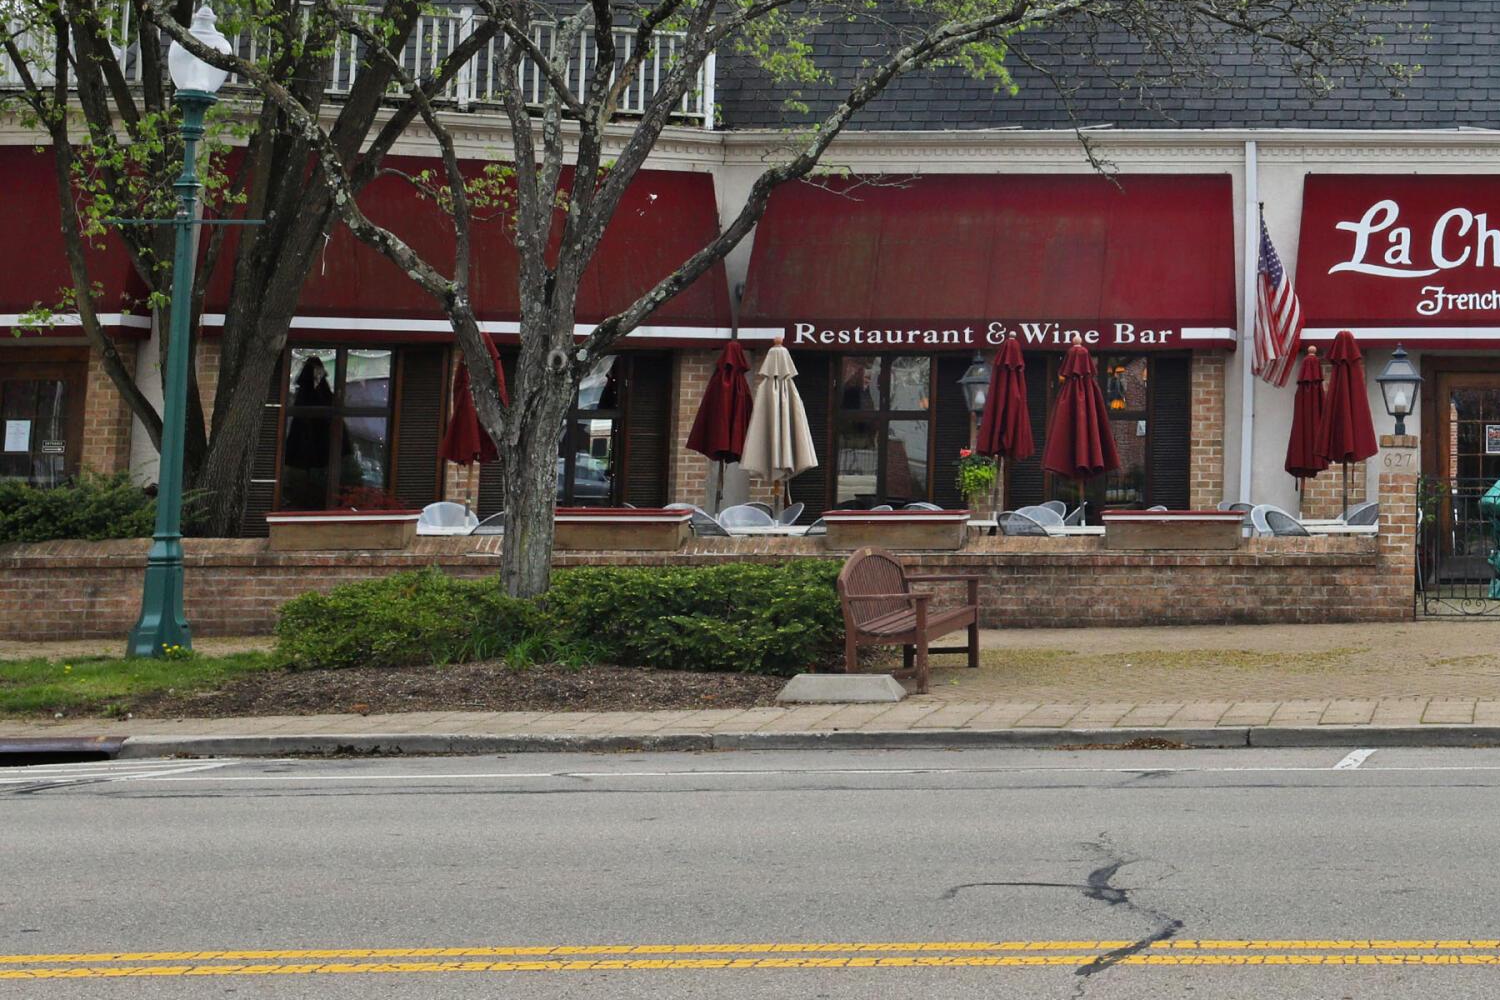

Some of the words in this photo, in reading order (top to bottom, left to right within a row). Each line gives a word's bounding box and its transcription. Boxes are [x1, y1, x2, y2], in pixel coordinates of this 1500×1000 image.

[1328, 199, 1440, 278] La
[793, 323, 974, 344] Restaurant
[986, 321, 1006, 344] &
[1019, 323, 1099, 344] Wine
[1113, 323, 1173, 344] Bar
[1384, 453, 1412, 467] 627
